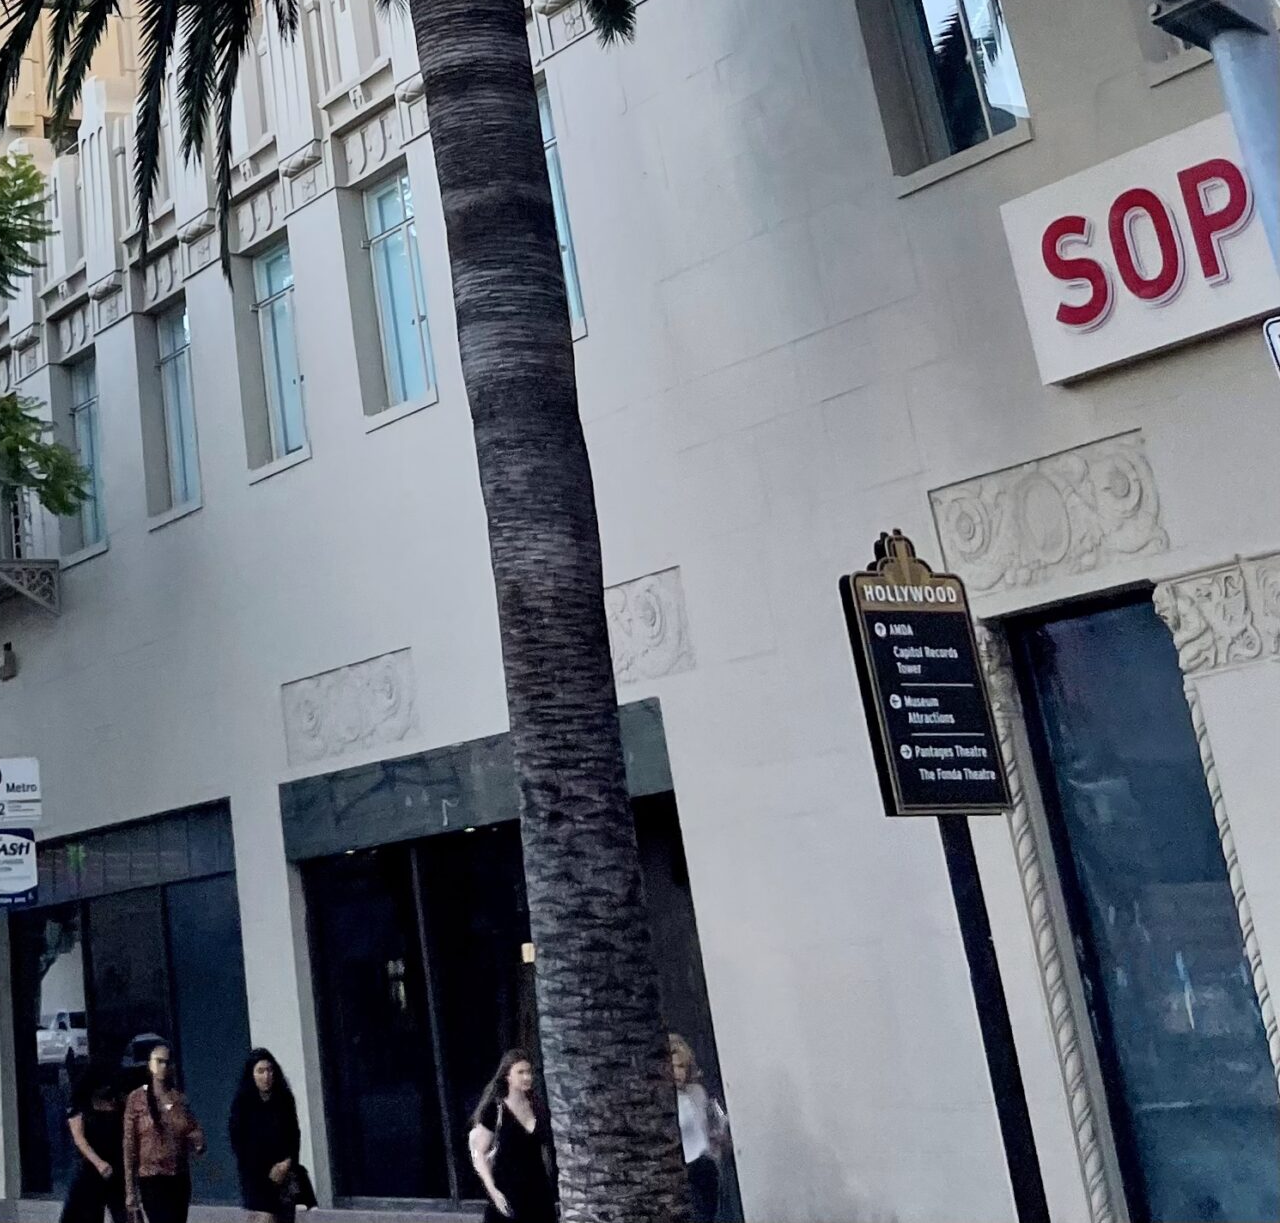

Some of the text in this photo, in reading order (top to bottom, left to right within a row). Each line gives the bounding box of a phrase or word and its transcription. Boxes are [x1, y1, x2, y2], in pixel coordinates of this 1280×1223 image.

[1041, 158, 1253, 329] SOP
[864, 584, 957, 603] HOLLYWOOD
[889, 623, 914, 636] AMDA
[892, 645, 959, 660] Capitol Records
[896, 661, 922, 674] Tower
[903, 695, 939, 708] Museum
[908, 711, 955, 725] Attractions
[915, 745, 987, 760] Pantages Theatre
[919, 768, 996, 781] The Fonda Theatre
[6, 782, 38, 793] Metro
